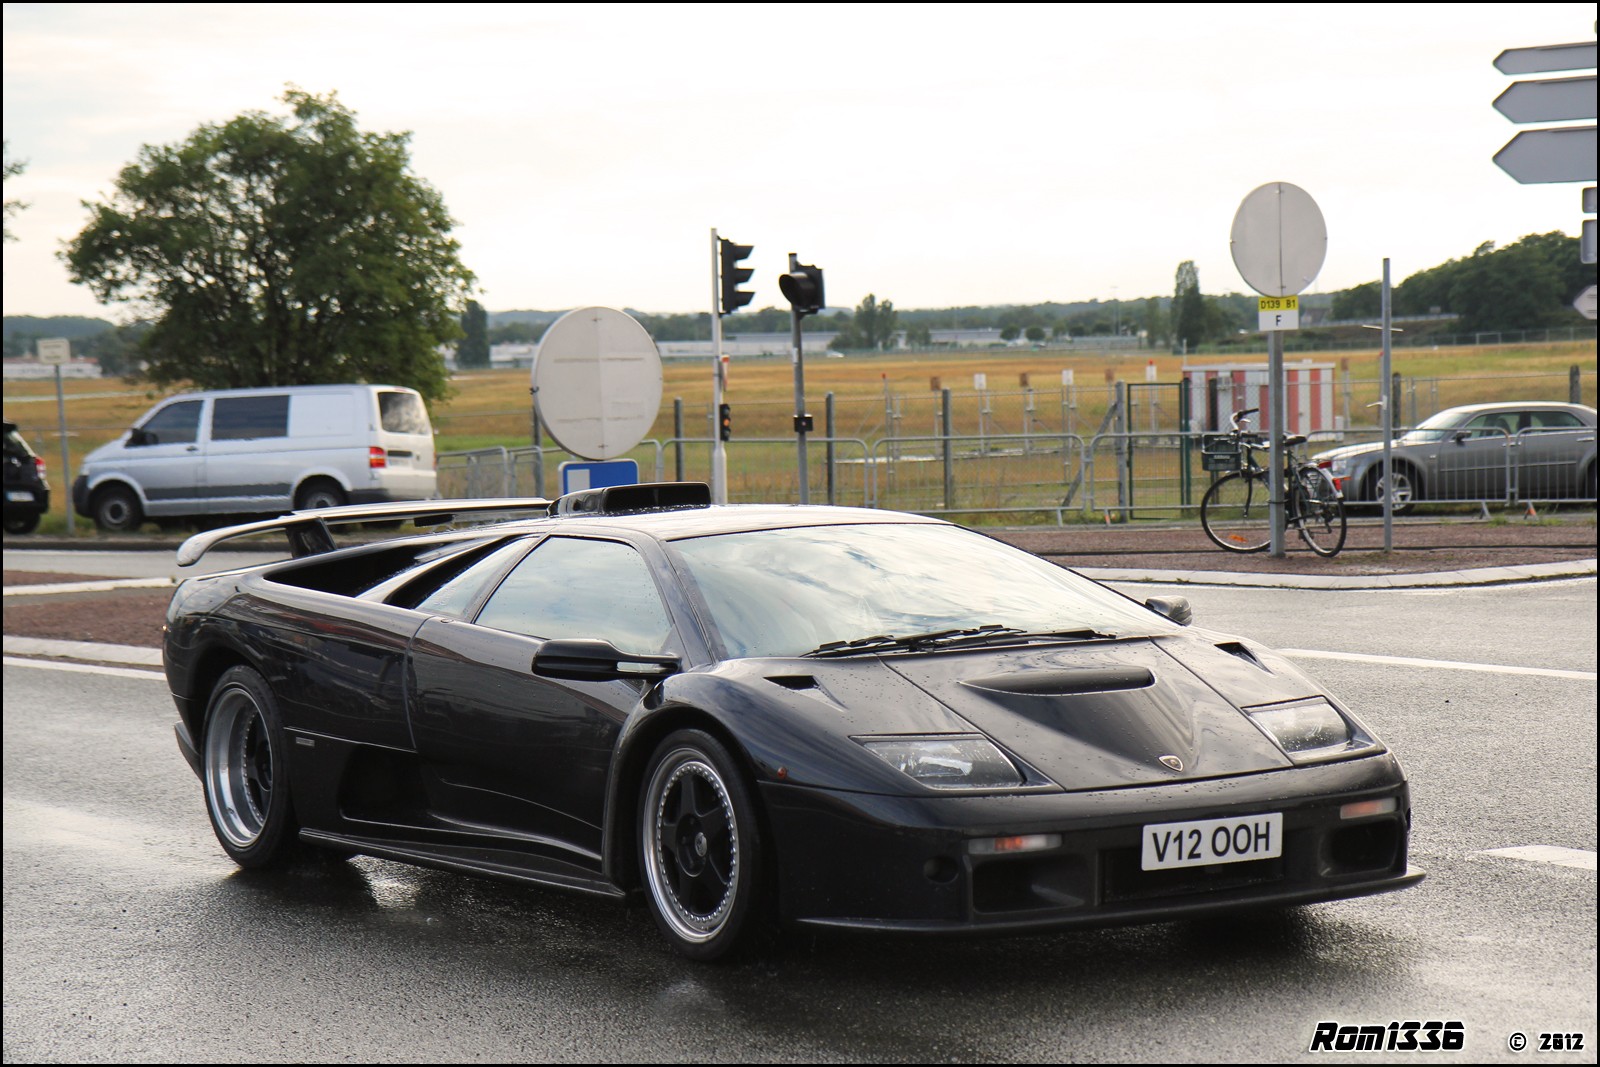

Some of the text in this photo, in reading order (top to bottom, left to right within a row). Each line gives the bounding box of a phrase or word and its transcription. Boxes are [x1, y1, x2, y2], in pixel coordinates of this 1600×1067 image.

[1260, 299, 1296, 310] D139 B1
[1275, 314, 1282, 327] F
[1152, 821, 1270, 862] V12 OOH
